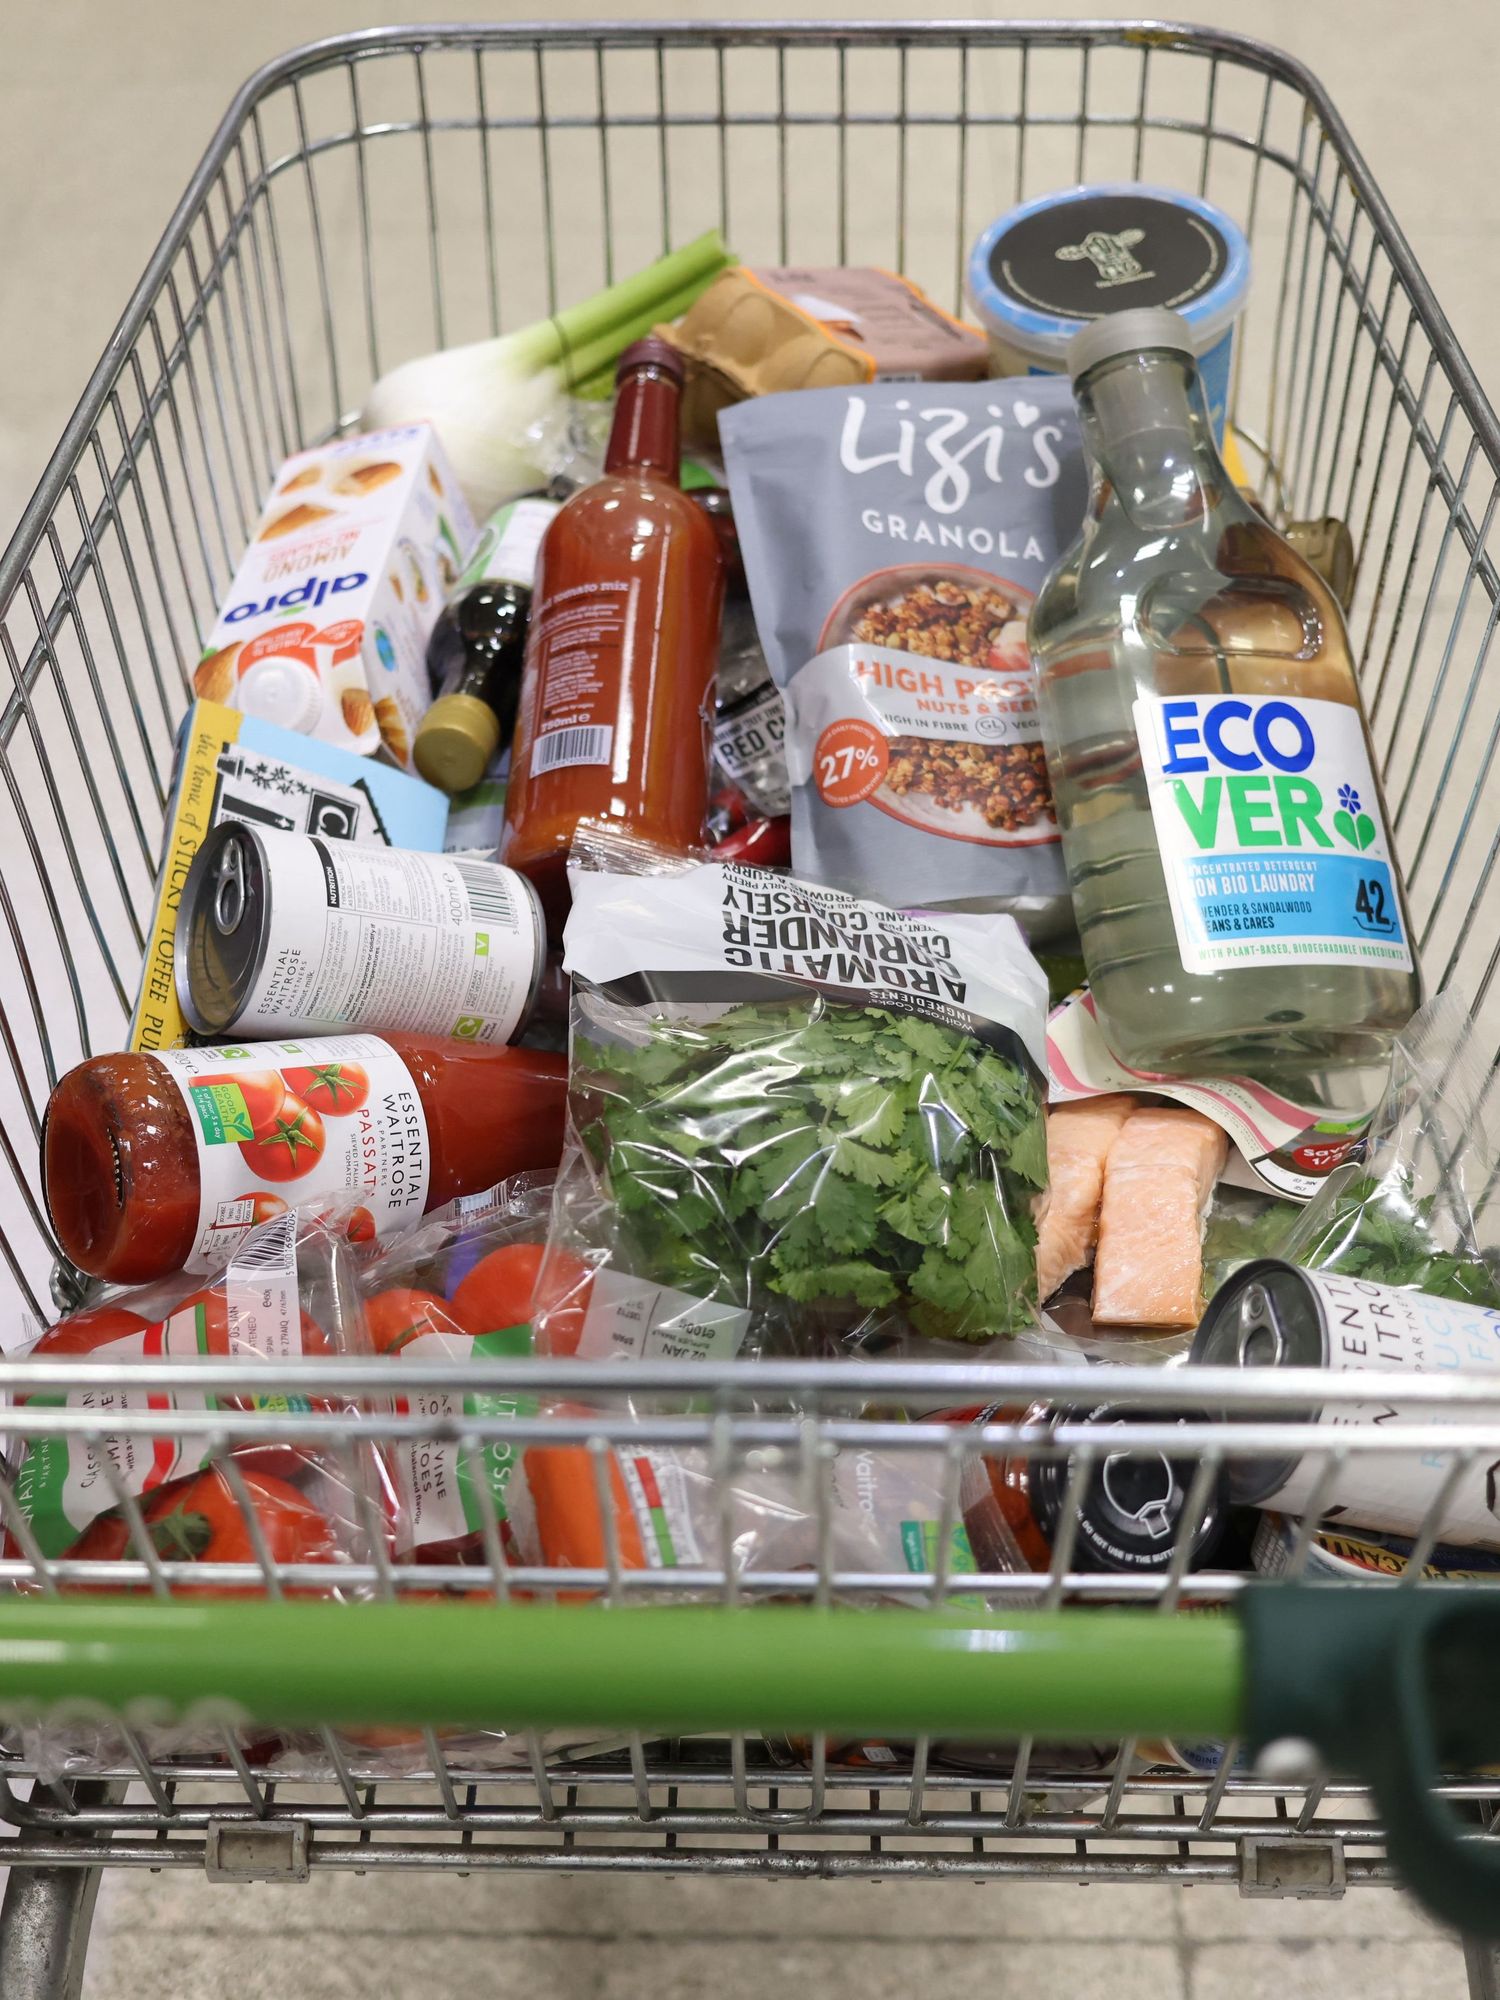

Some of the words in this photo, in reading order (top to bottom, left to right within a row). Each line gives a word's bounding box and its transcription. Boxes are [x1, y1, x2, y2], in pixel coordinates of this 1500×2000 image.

[862, 509, 1044, 562] GRANOLA
[223, 573, 369, 623] alpro
[600, 581, 630, 592] mix
[857, 661, 944, 697] HIGH
[915, 698, 970, 716] NUTS
[915, 718, 929, 728] IN
[933, 721, 969, 732] FIBRE
[1011, 719, 1040, 730] VEG
[1161, 700, 1315, 774] ECO
[719, 730, 766, 764] RED
[820, 745, 879, 788] 27%
[187, 765, 212, 806] home
[179, 812, 202, 832] of
[1164, 775, 1336, 850] VER
[167, 836, 199, 912] STICKY
[723, 865, 772, 881] CURRY
[723, 873, 758, 889] PRETTY
[1264, 860, 1317, 872] DETERGENT
[326, 866, 338, 904] NUTRITION
[1222, 875, 1248, 894] BIO
[1252, 874, 1315, 893] LAUNDRY
[723, 885, 868, 931] COARSELY
[1243, 902, 1250, 914] &
[1251, 901, 1313, 915] SANDALWOOD
[1355, 879, 1390, 925] 42
[1234, 918, 1242, 931] &
[1243, 916, 1275, 930] CARES
[368, 930, 376, 952] solidify
[721, 911, 962, 980] CORIANDER
[1293, 943, 1358, 956] BIODEGRADABLE
[1358, 946, 1404, 961] INGREDIENTS
[149, 928, 175, 1005] TOFFEE
[258, 949, 289, 1014] ESSENTIAL
[270, 950, 300, 1014] WAITROSE
[358, 962, 371, 989] separate
[361, 990, 369, 1000] low
[365, 946, 380, 989] temperatures.
[723, 947, 966, 1004] AROMATIC
[289, 990, 308, 1017] Coconut
[354, 990, 363, 1002] may
[464, 970, 479, 1006] VEGETARIAN
[470, 994, 478, 1007] AND
[474, 971, 484, 992] VEGAN
[345, 1003, 357, 1021] Product
[868, 990, 971, 1022] INGREDIENTS
[916, 1007, 975, 1034] Waitrose
[198, 1104, 211, 1119] pack
[212, 1087, 231, 1123] HEALTH
[221, 1086, 236, 1114] GOOD
[203, 1100, 215, 1115] your
[214, 1127, 222, 1138] day
[350, 1133, 358, 1158] SIEVED
[378, 1130, 388, 1187] PARTNERS
[382, 1093, 402, 1209] WAITROSE
[399, 1091, 421, 1207] ESSENTIAL
[1303, 1142, 1351, 1157] Save
[1312, 1152, 1343, 1166] 1/3
[235, 1203, 243, 1222] Energy
[265, 1336, 274, 1353] SPAIN
[661, 1344, 690, 1358] JAN
[1091, 1530, 1108, 1550] NOT
[1107, 1545, 1126, 1560] USE
[1125, 1551, 1134, 1562] IF
[1134, 1554, 1152, 1565] THE
